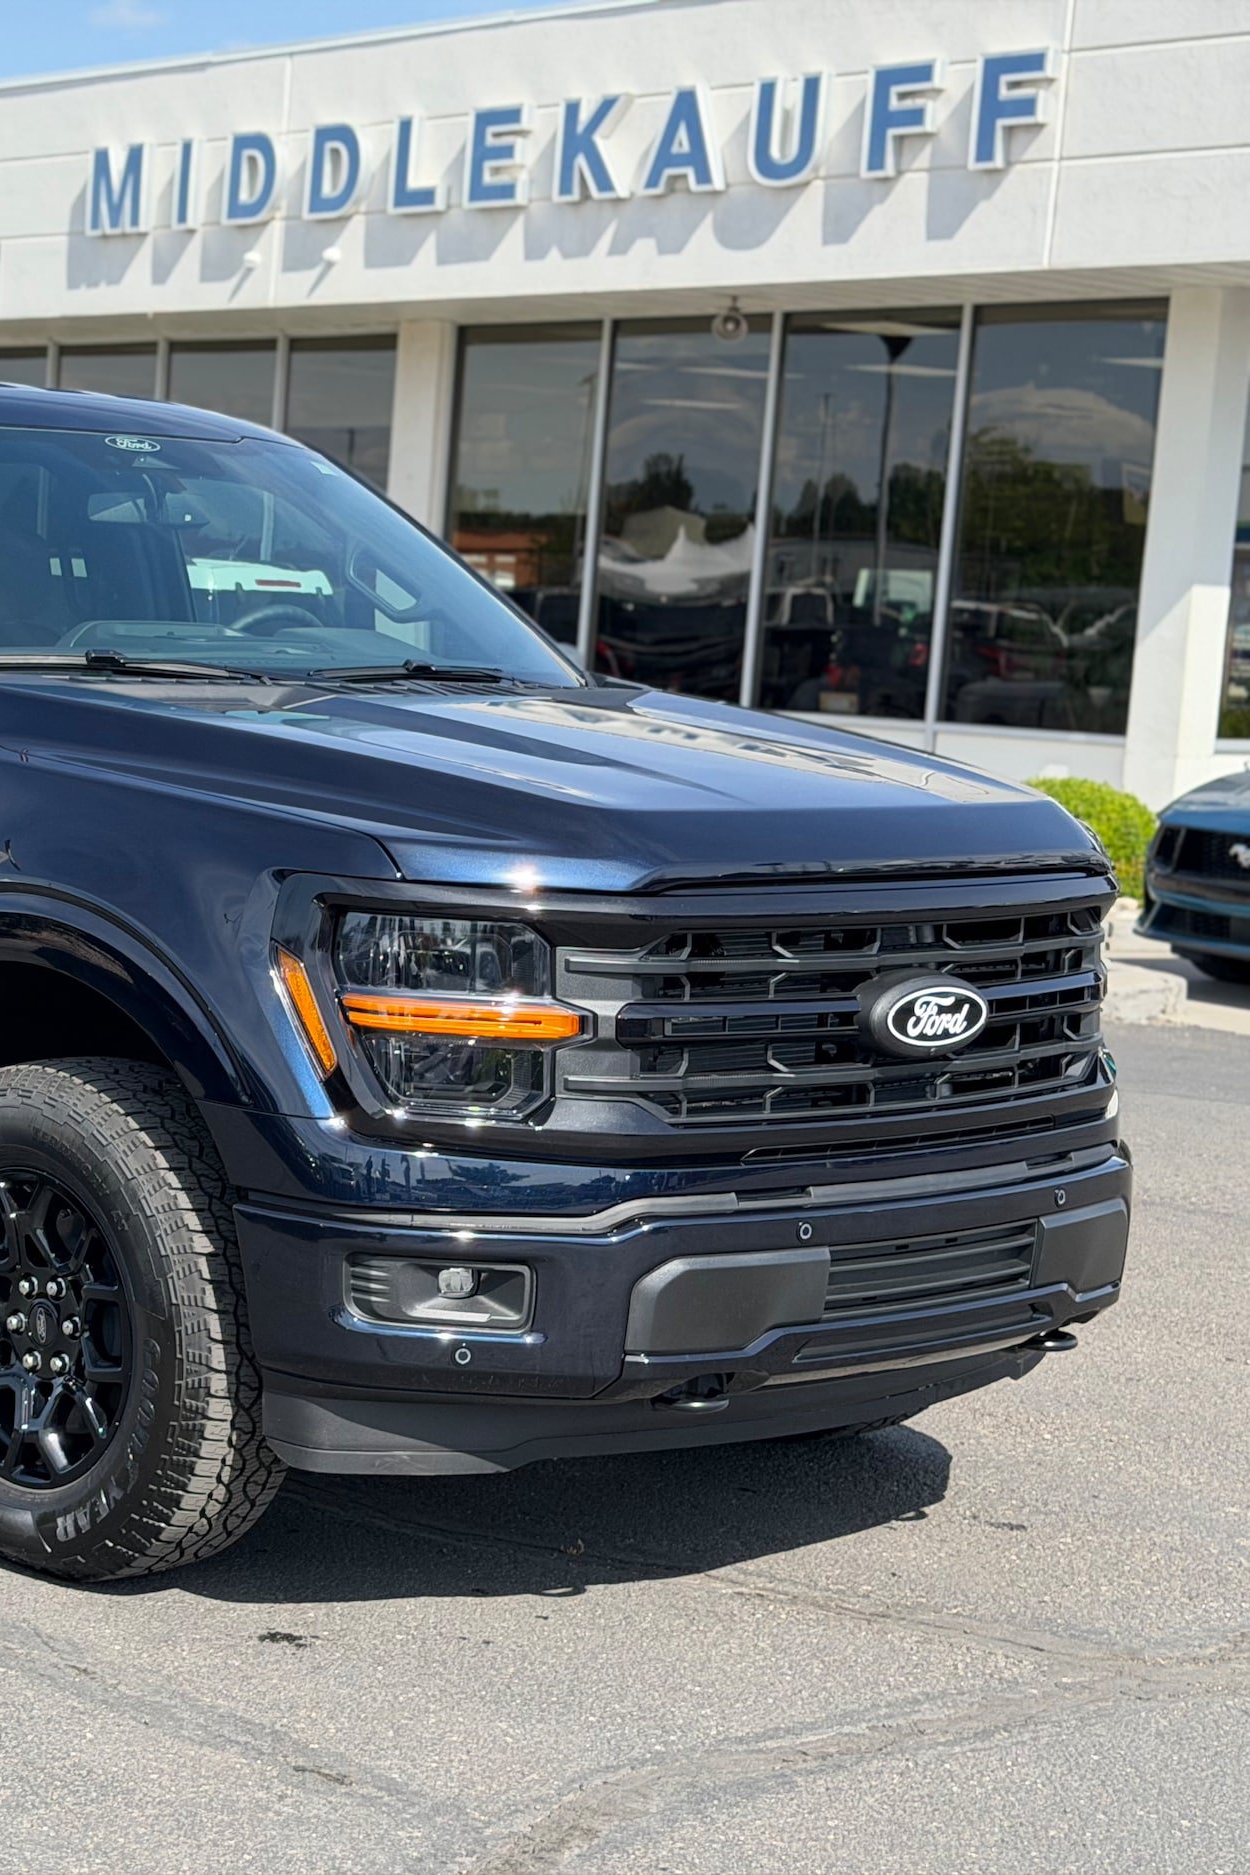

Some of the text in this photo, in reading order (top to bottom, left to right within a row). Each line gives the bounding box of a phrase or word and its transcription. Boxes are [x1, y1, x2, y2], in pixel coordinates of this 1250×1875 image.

[85, 47, 1053, 237] MIDDLEKAUFF
[115, 438, 152, 450] Ford
[906, 996, 970, 1037] Ford
